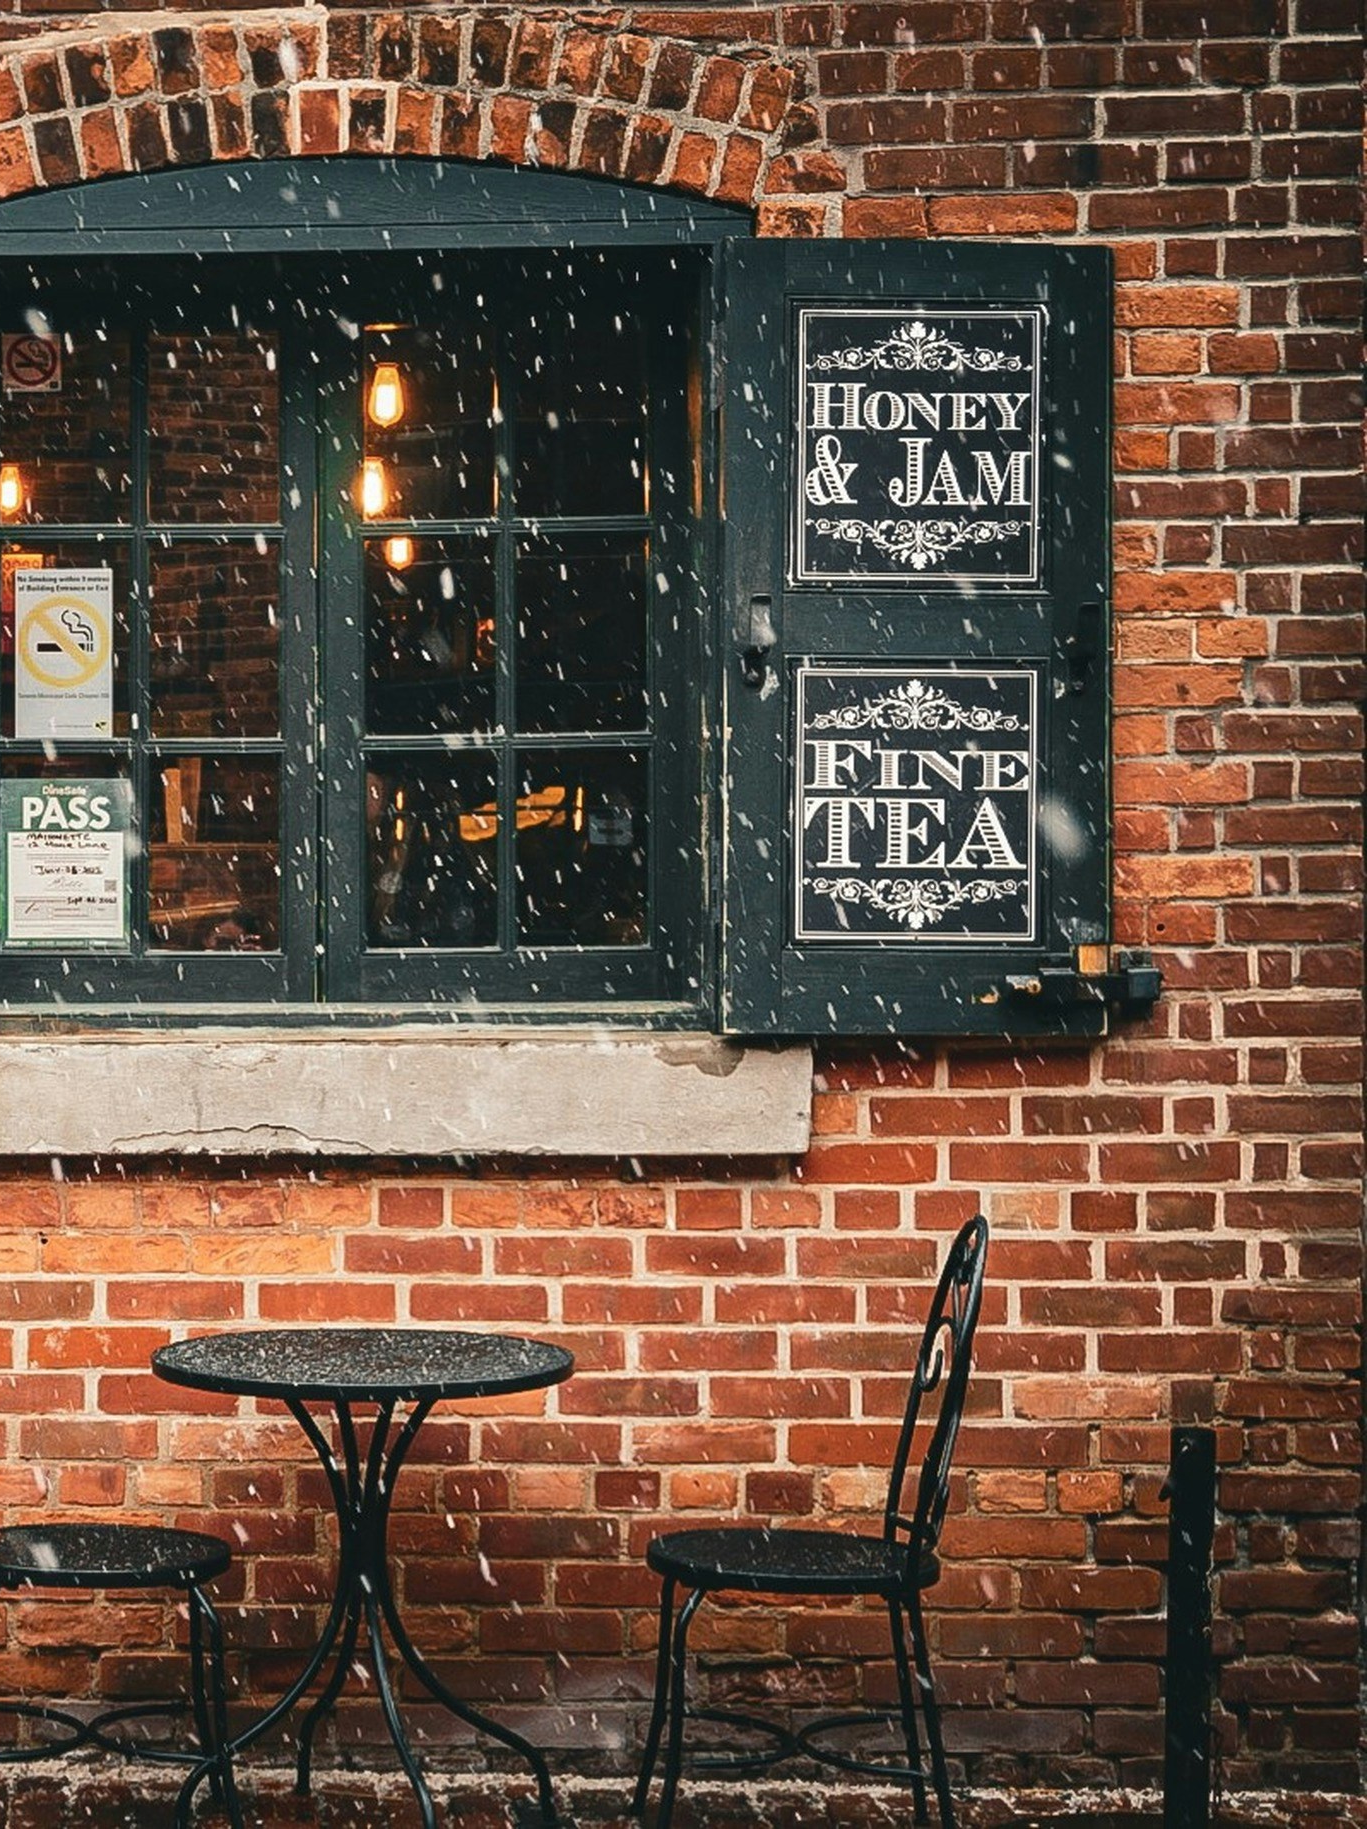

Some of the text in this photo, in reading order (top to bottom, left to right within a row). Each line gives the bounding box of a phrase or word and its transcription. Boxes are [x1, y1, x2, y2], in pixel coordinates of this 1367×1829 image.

[807, 382, 1030, 432] HONEY
[805, 434, 1031, 507] & JAM
[804, 740, 1029, 791] FINE
[22, 796, 111, 830] PASS
[804, 797, 1027, 869] TEA
